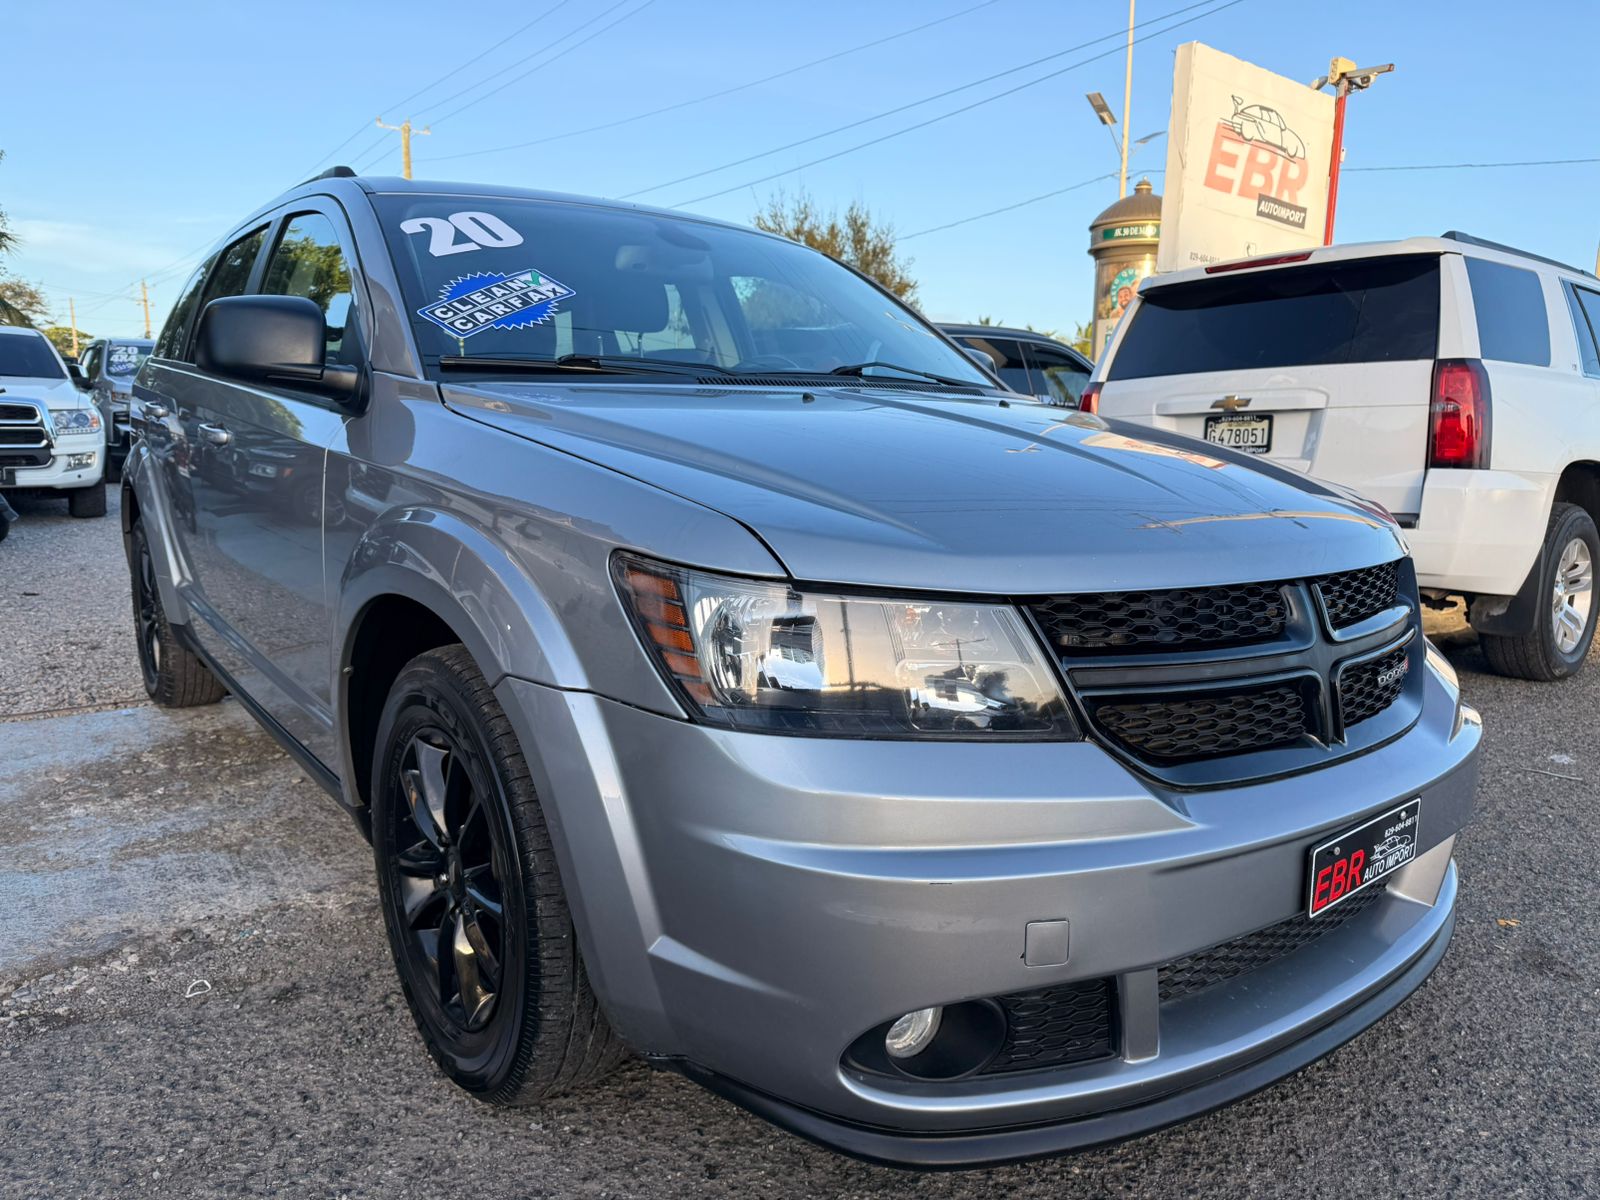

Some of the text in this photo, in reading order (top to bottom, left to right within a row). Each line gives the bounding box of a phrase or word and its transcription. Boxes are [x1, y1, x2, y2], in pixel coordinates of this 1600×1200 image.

[1204, 122, 1309, 204] EBR
[1258, 200, 1306, 224] AUTOIMPORT
[400, 211, 524, 257] 20
[434, 278, 528, 319] CLEAN
[453, 286, 563, 330] CARFAX
[1209, 427, 1266, 445] G478051
[1313, 849, 1365, 912] EBR
[1363, 843, 1414, 882] AUTO IMPORT
